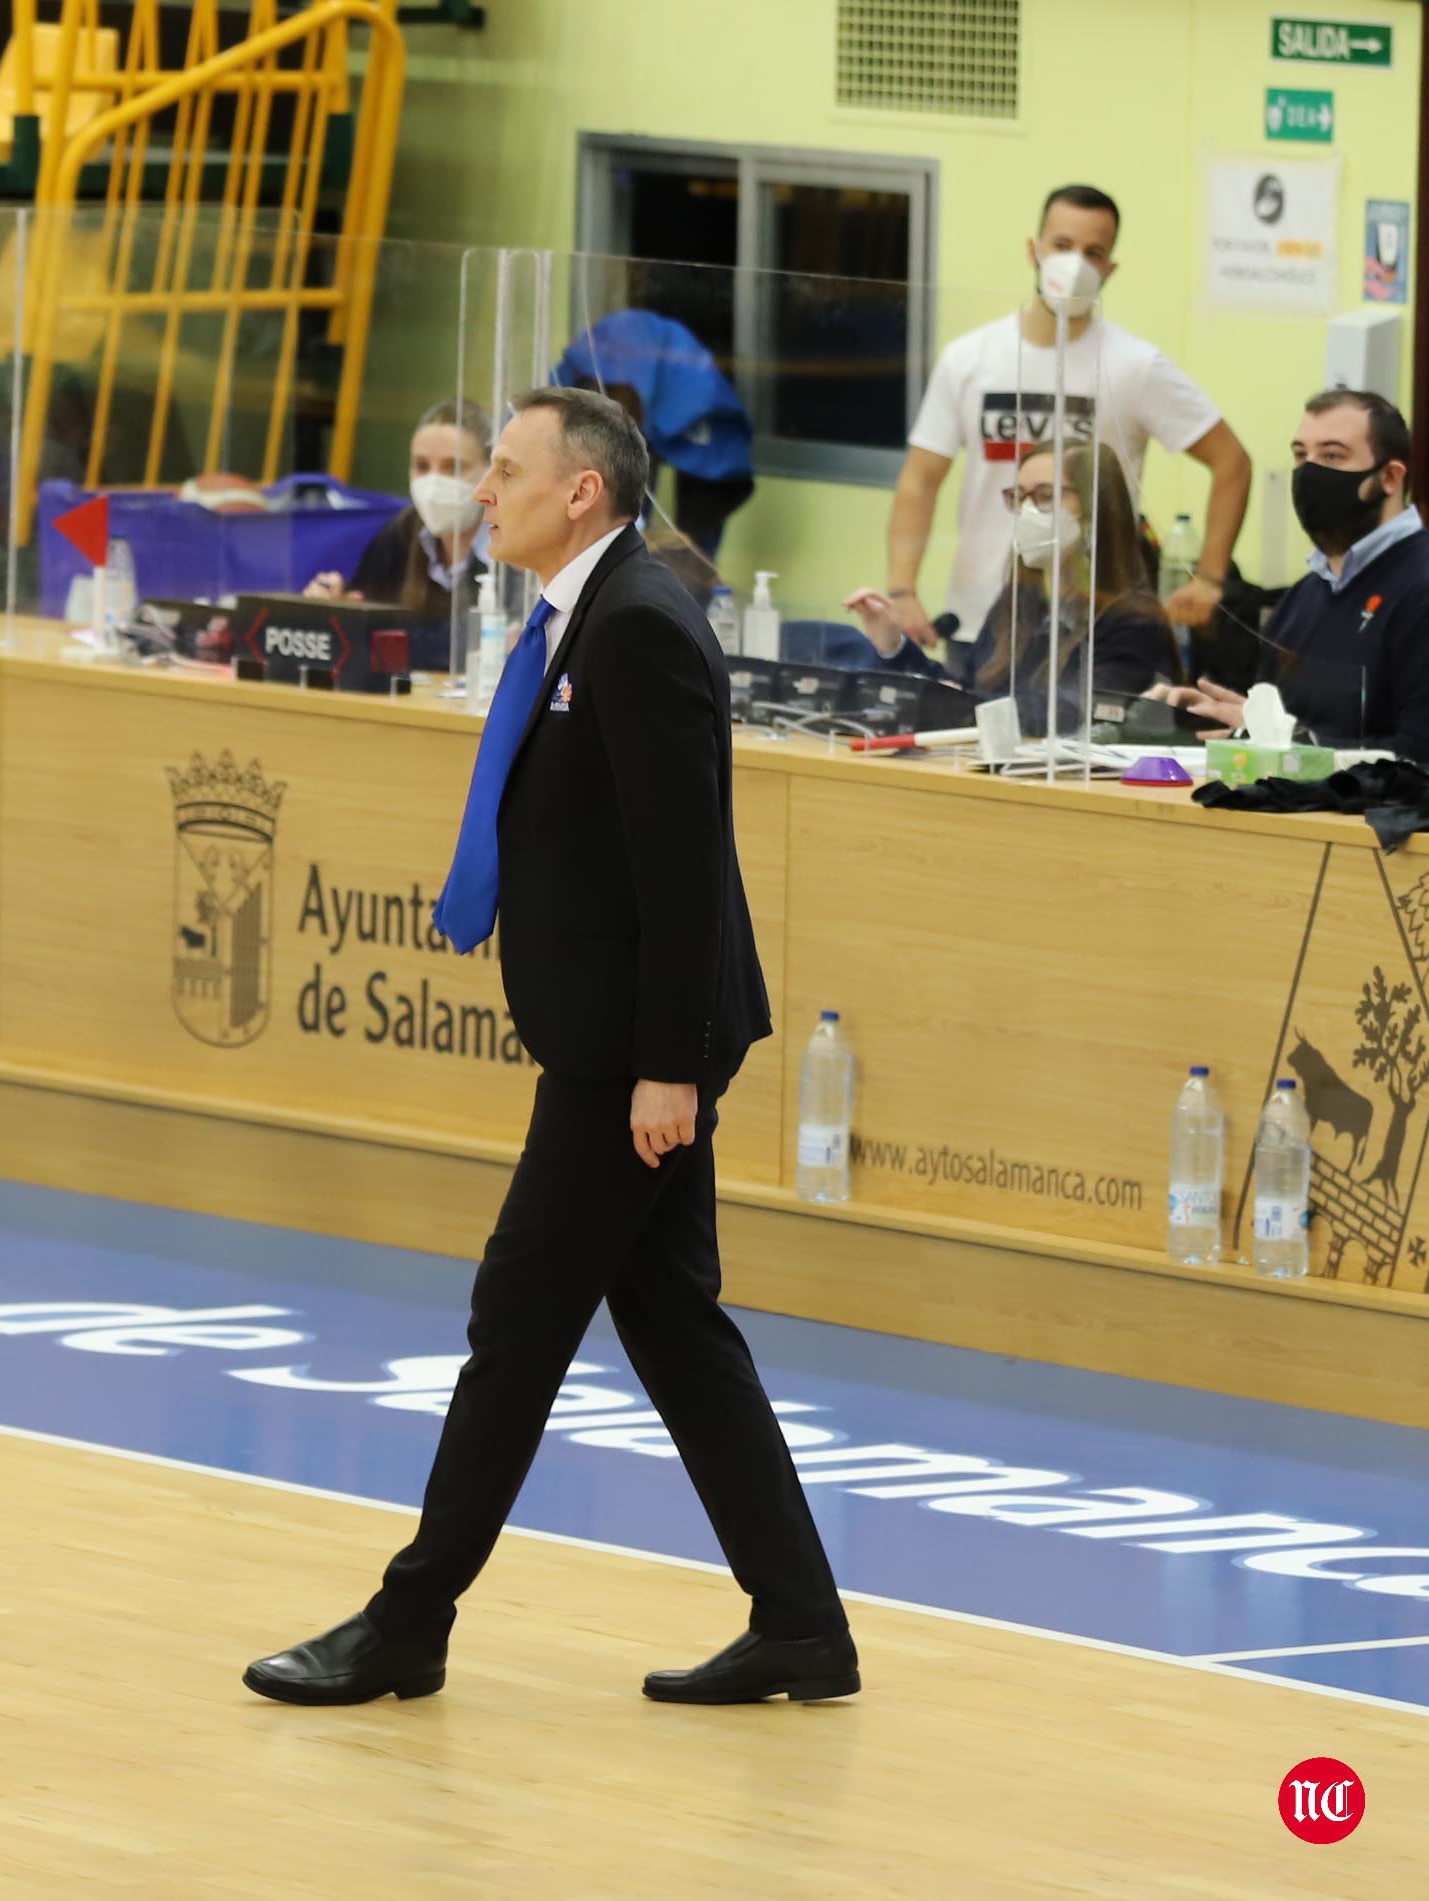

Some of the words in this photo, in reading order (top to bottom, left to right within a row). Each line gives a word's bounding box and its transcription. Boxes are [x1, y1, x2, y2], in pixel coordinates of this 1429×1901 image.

[1277, 22, 1351, 60] SALIDA
[264, 626, 332, 662] POSSE
[296, 962, 348, 1037] de
[364, 970, 537, 1067] Salama
[850, 1132, 1143, 1210] www.aytosalamanca.com
